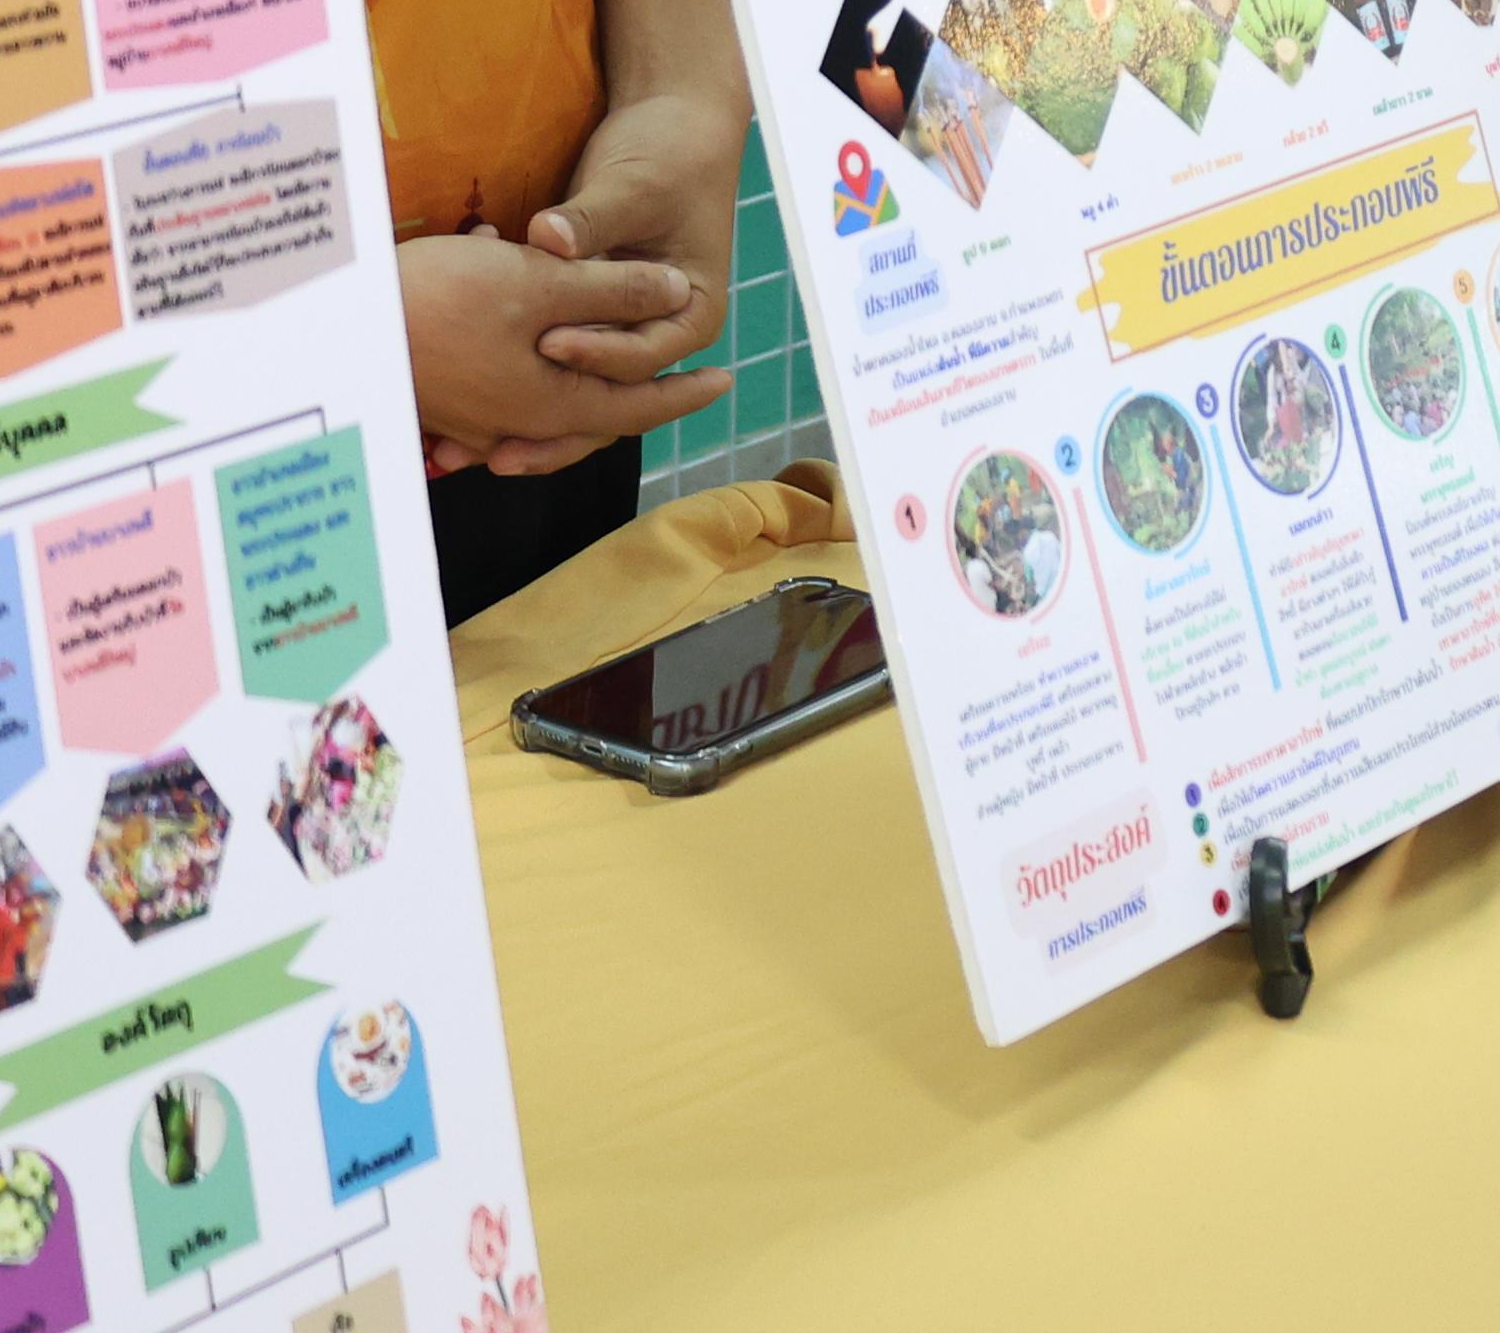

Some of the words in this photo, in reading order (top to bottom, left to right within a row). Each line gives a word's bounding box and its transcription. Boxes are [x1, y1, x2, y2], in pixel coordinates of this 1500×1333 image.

[1160, 154, 1441, 306] ขั้นตอนการประกอบพิธี
[1329, 330, 1343, 353] 4
[1061, 443, 1077, 468] 2
[1015, 805, 1152, 911] วัตถุประสงค์
